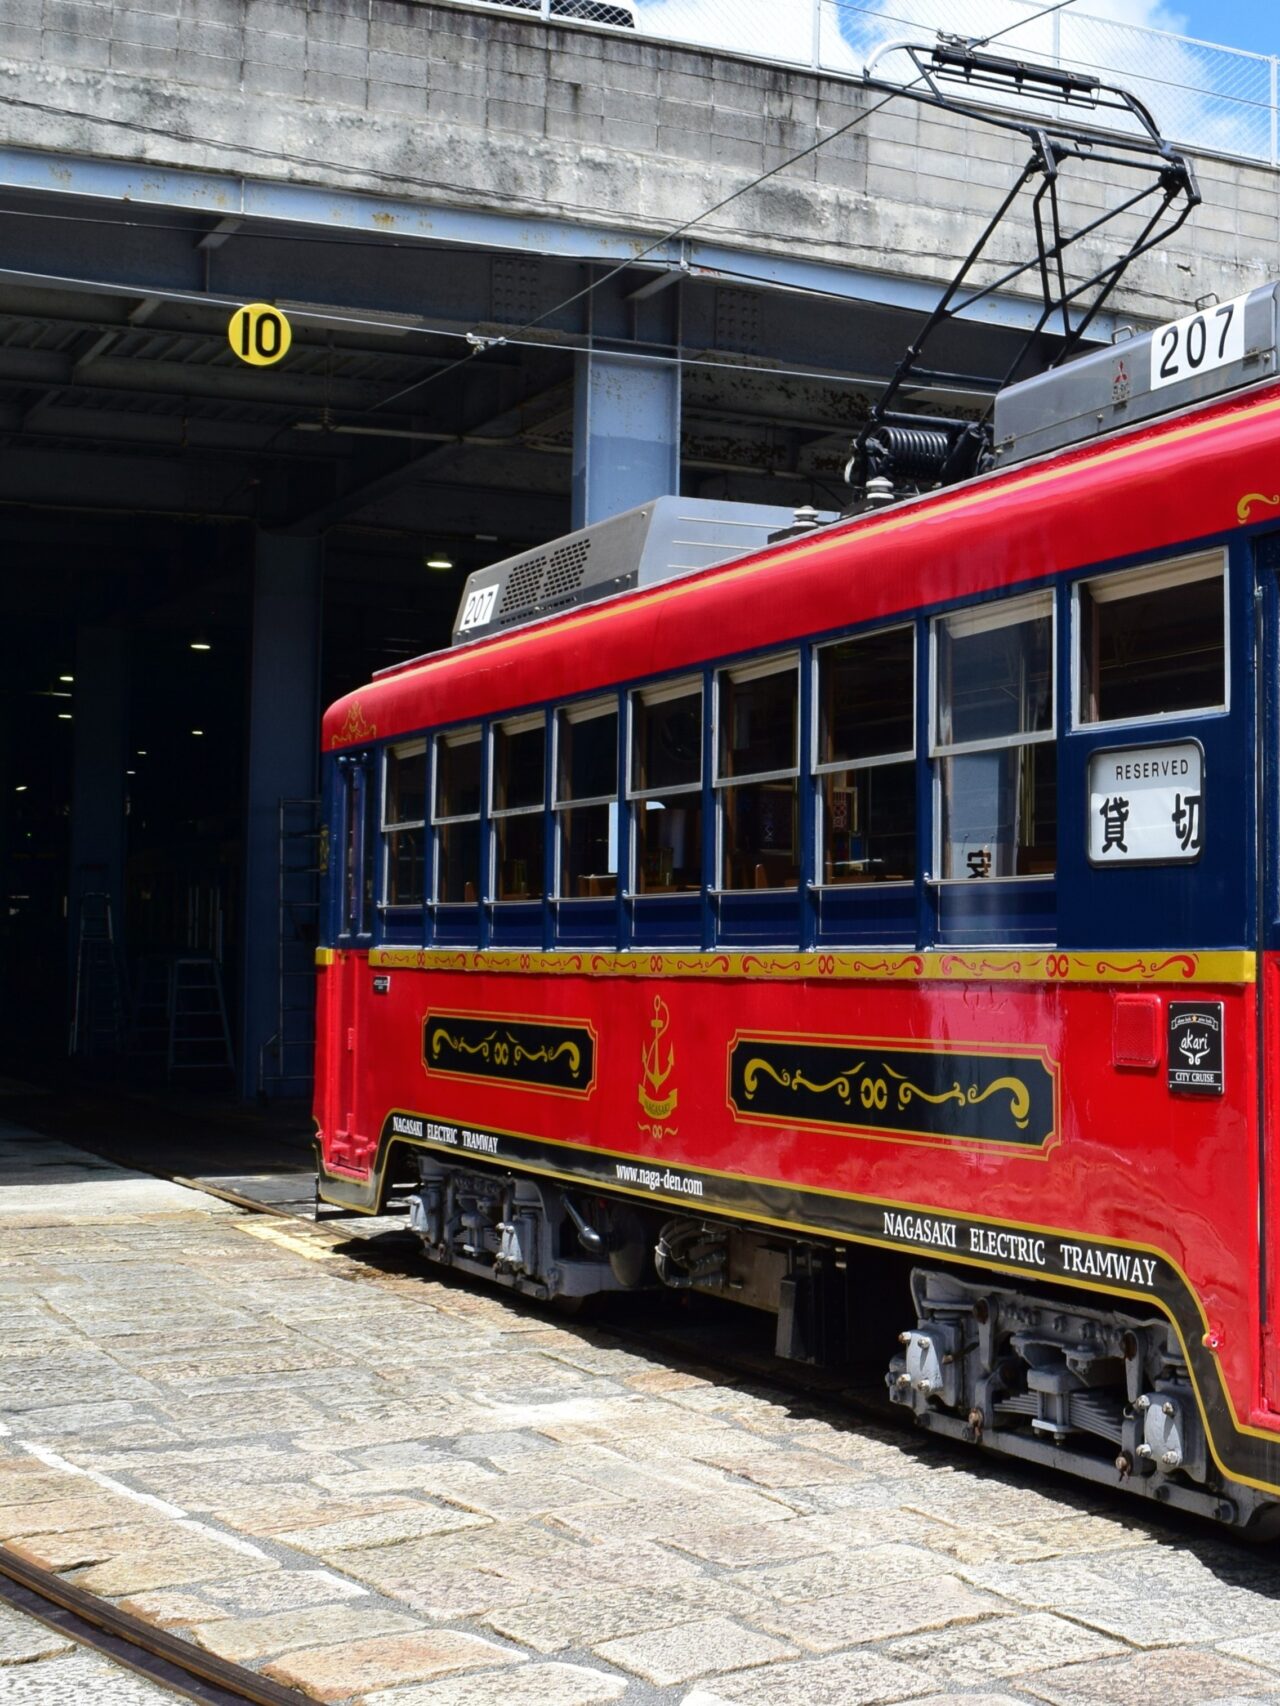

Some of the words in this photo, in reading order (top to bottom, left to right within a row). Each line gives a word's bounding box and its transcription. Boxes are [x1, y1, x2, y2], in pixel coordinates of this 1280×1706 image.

[242, 312, 281, 358] 10
[1160, 304, 1234, 379] 207
[464, 591, 494, 625] 207
[1116, 759, 1189, 780] RESERVED
[1181, 1028, 1208, 1050] akari
[1175, 1072, 1190, 1082] CITY
[1192, 1073, 1215, 1083] CRUISE
[393, 1116, 423, 1137] NAGASAKI
[427, 1123, 458, 1145] ELECTRIC
[462, 1130, 499, 1153] TRAMWAY
[616, 1164, 703, 1196] www.naga-den.com
[883, 1212, 957, 1248] NAGASAKI
[969, 1228, 1046, 1265] ELECTRIC
[1060, 1244, 1157, 1287] TRAMWAY
